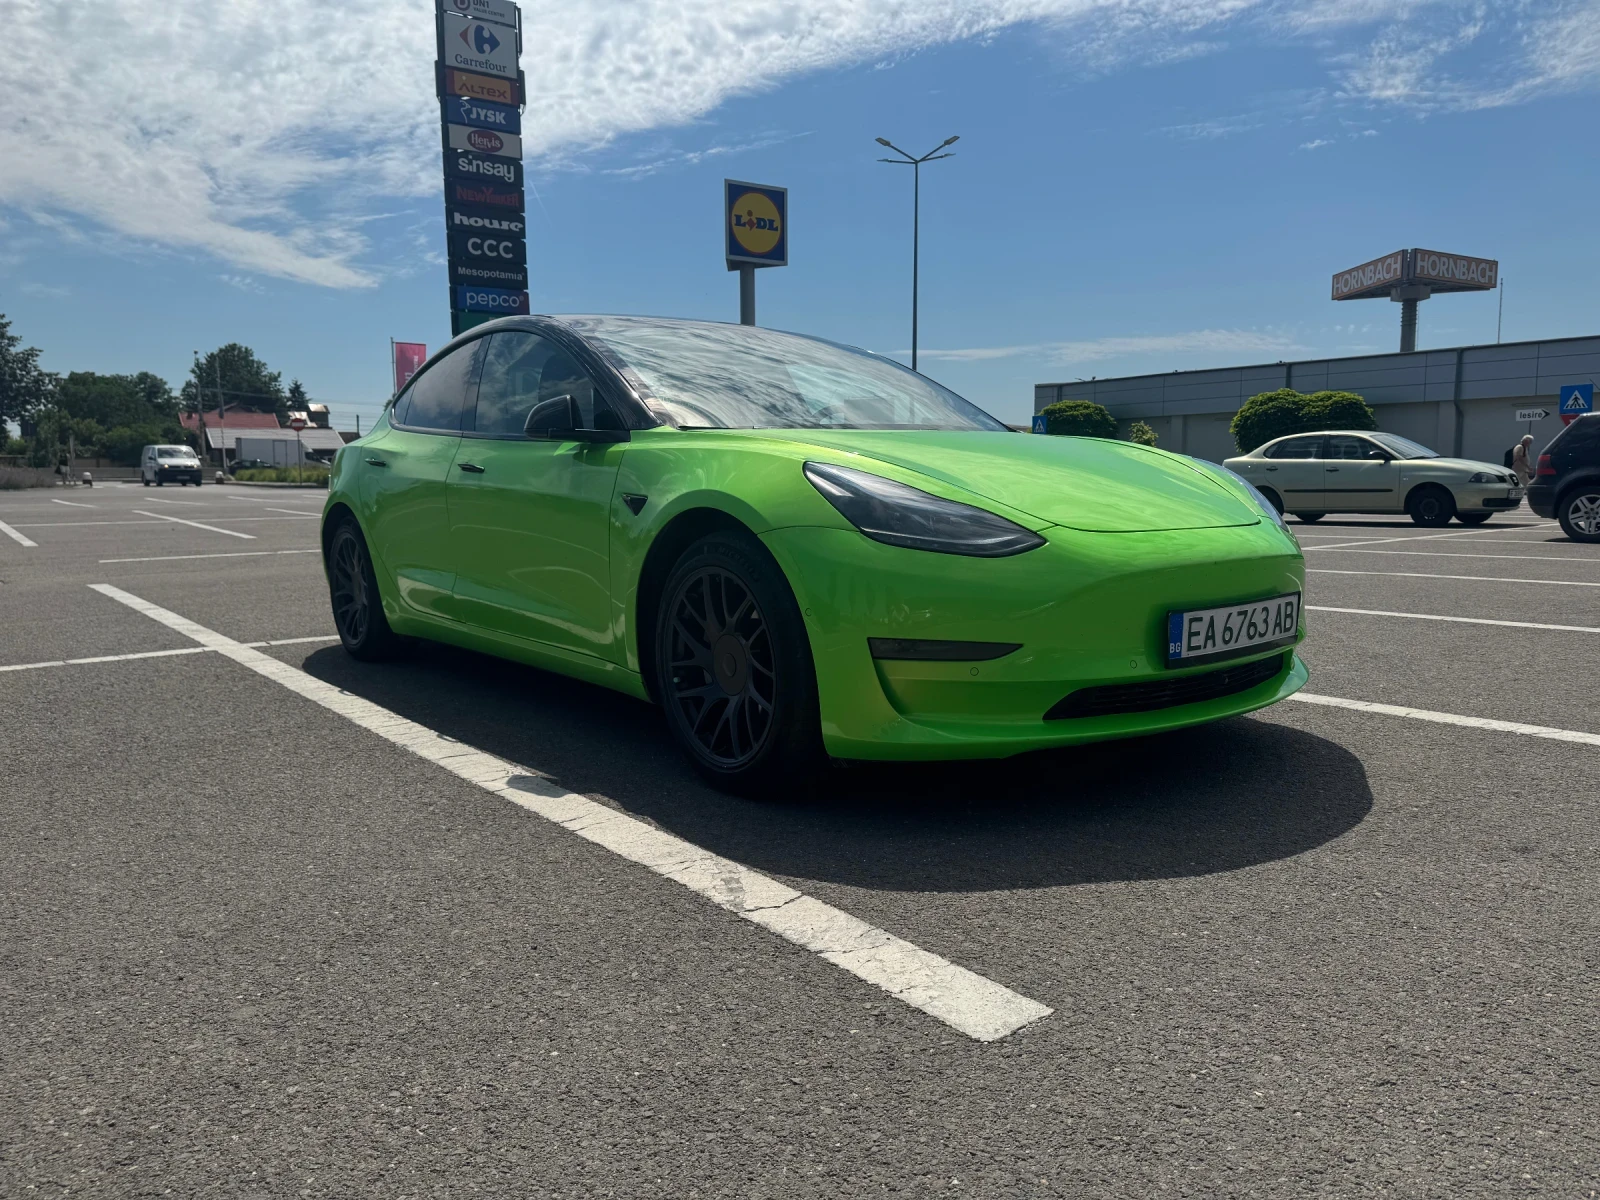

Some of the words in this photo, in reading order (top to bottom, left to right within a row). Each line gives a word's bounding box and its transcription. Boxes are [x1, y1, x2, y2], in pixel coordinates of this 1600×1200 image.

[454, 54, 507, 73] Carrefour
[470, 107, 506, 124] JYSK
[471, 132, 501, 148] Hervis
[458, 155, 514, 182] sinsay
[453, 212, 524, 231] house
[467, 237, 513, 258] CCC
[458, 266, 523, 280] Mesopotamia
[1333, 254, 1401, 295] HORNBACH
[1417, 253, 1496, 284] HORNBACH
[466, 292, 520, 307] pepco
[1187, 615, 1216, 652] EA
[1222, 606, 1269, 645] 6763
[1272, 601, 1294, 636] AB
[1169, 642, 1181, 654] BG
